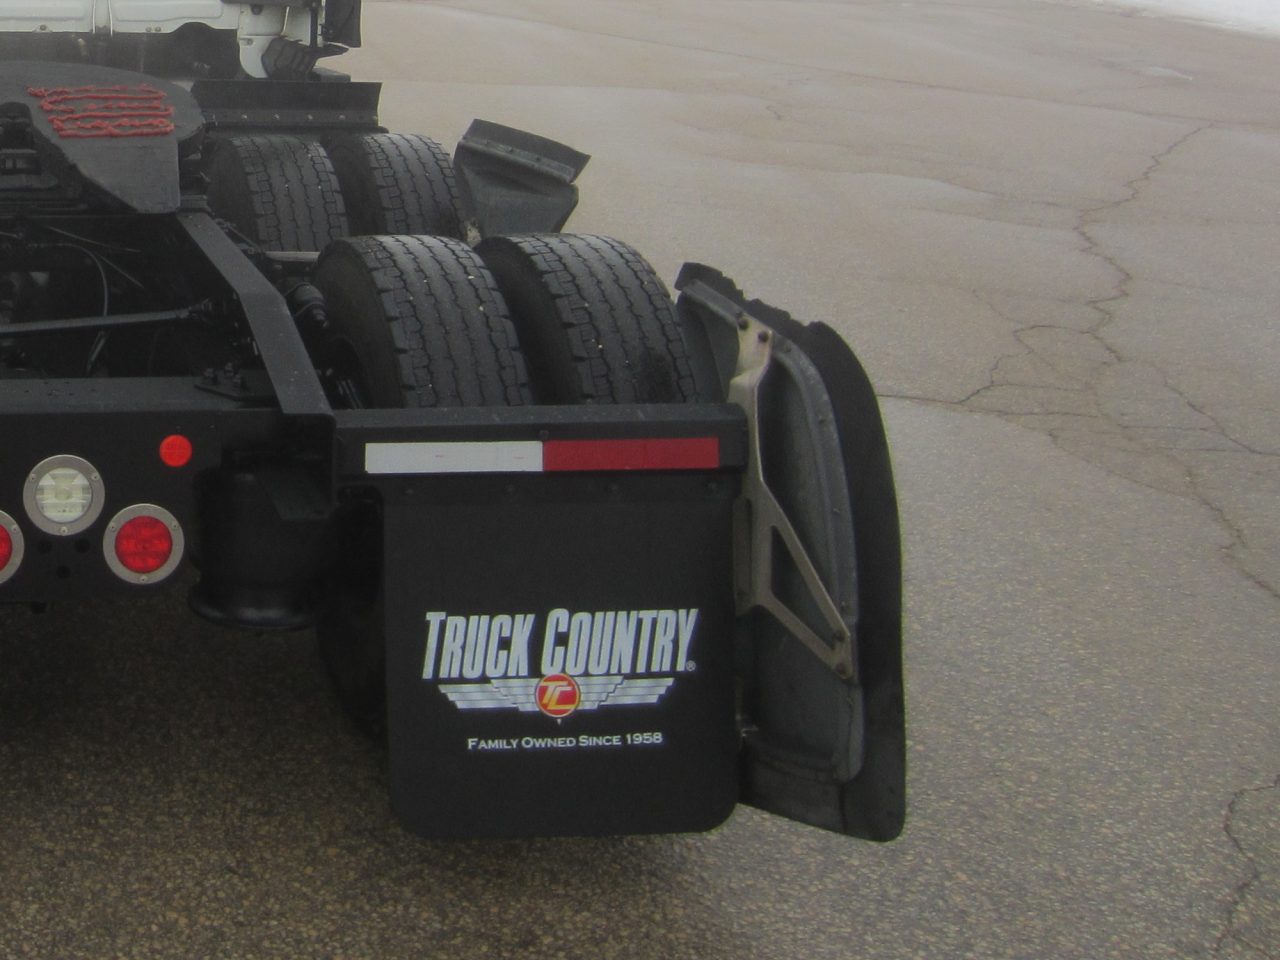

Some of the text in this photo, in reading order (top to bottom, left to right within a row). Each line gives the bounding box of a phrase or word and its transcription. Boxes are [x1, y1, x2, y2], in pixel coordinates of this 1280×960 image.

[422, 608, 699, 680] TRUCK COUNTRY
[467, 731, 663, 751] FAMILY OWNED SINCE 1958
